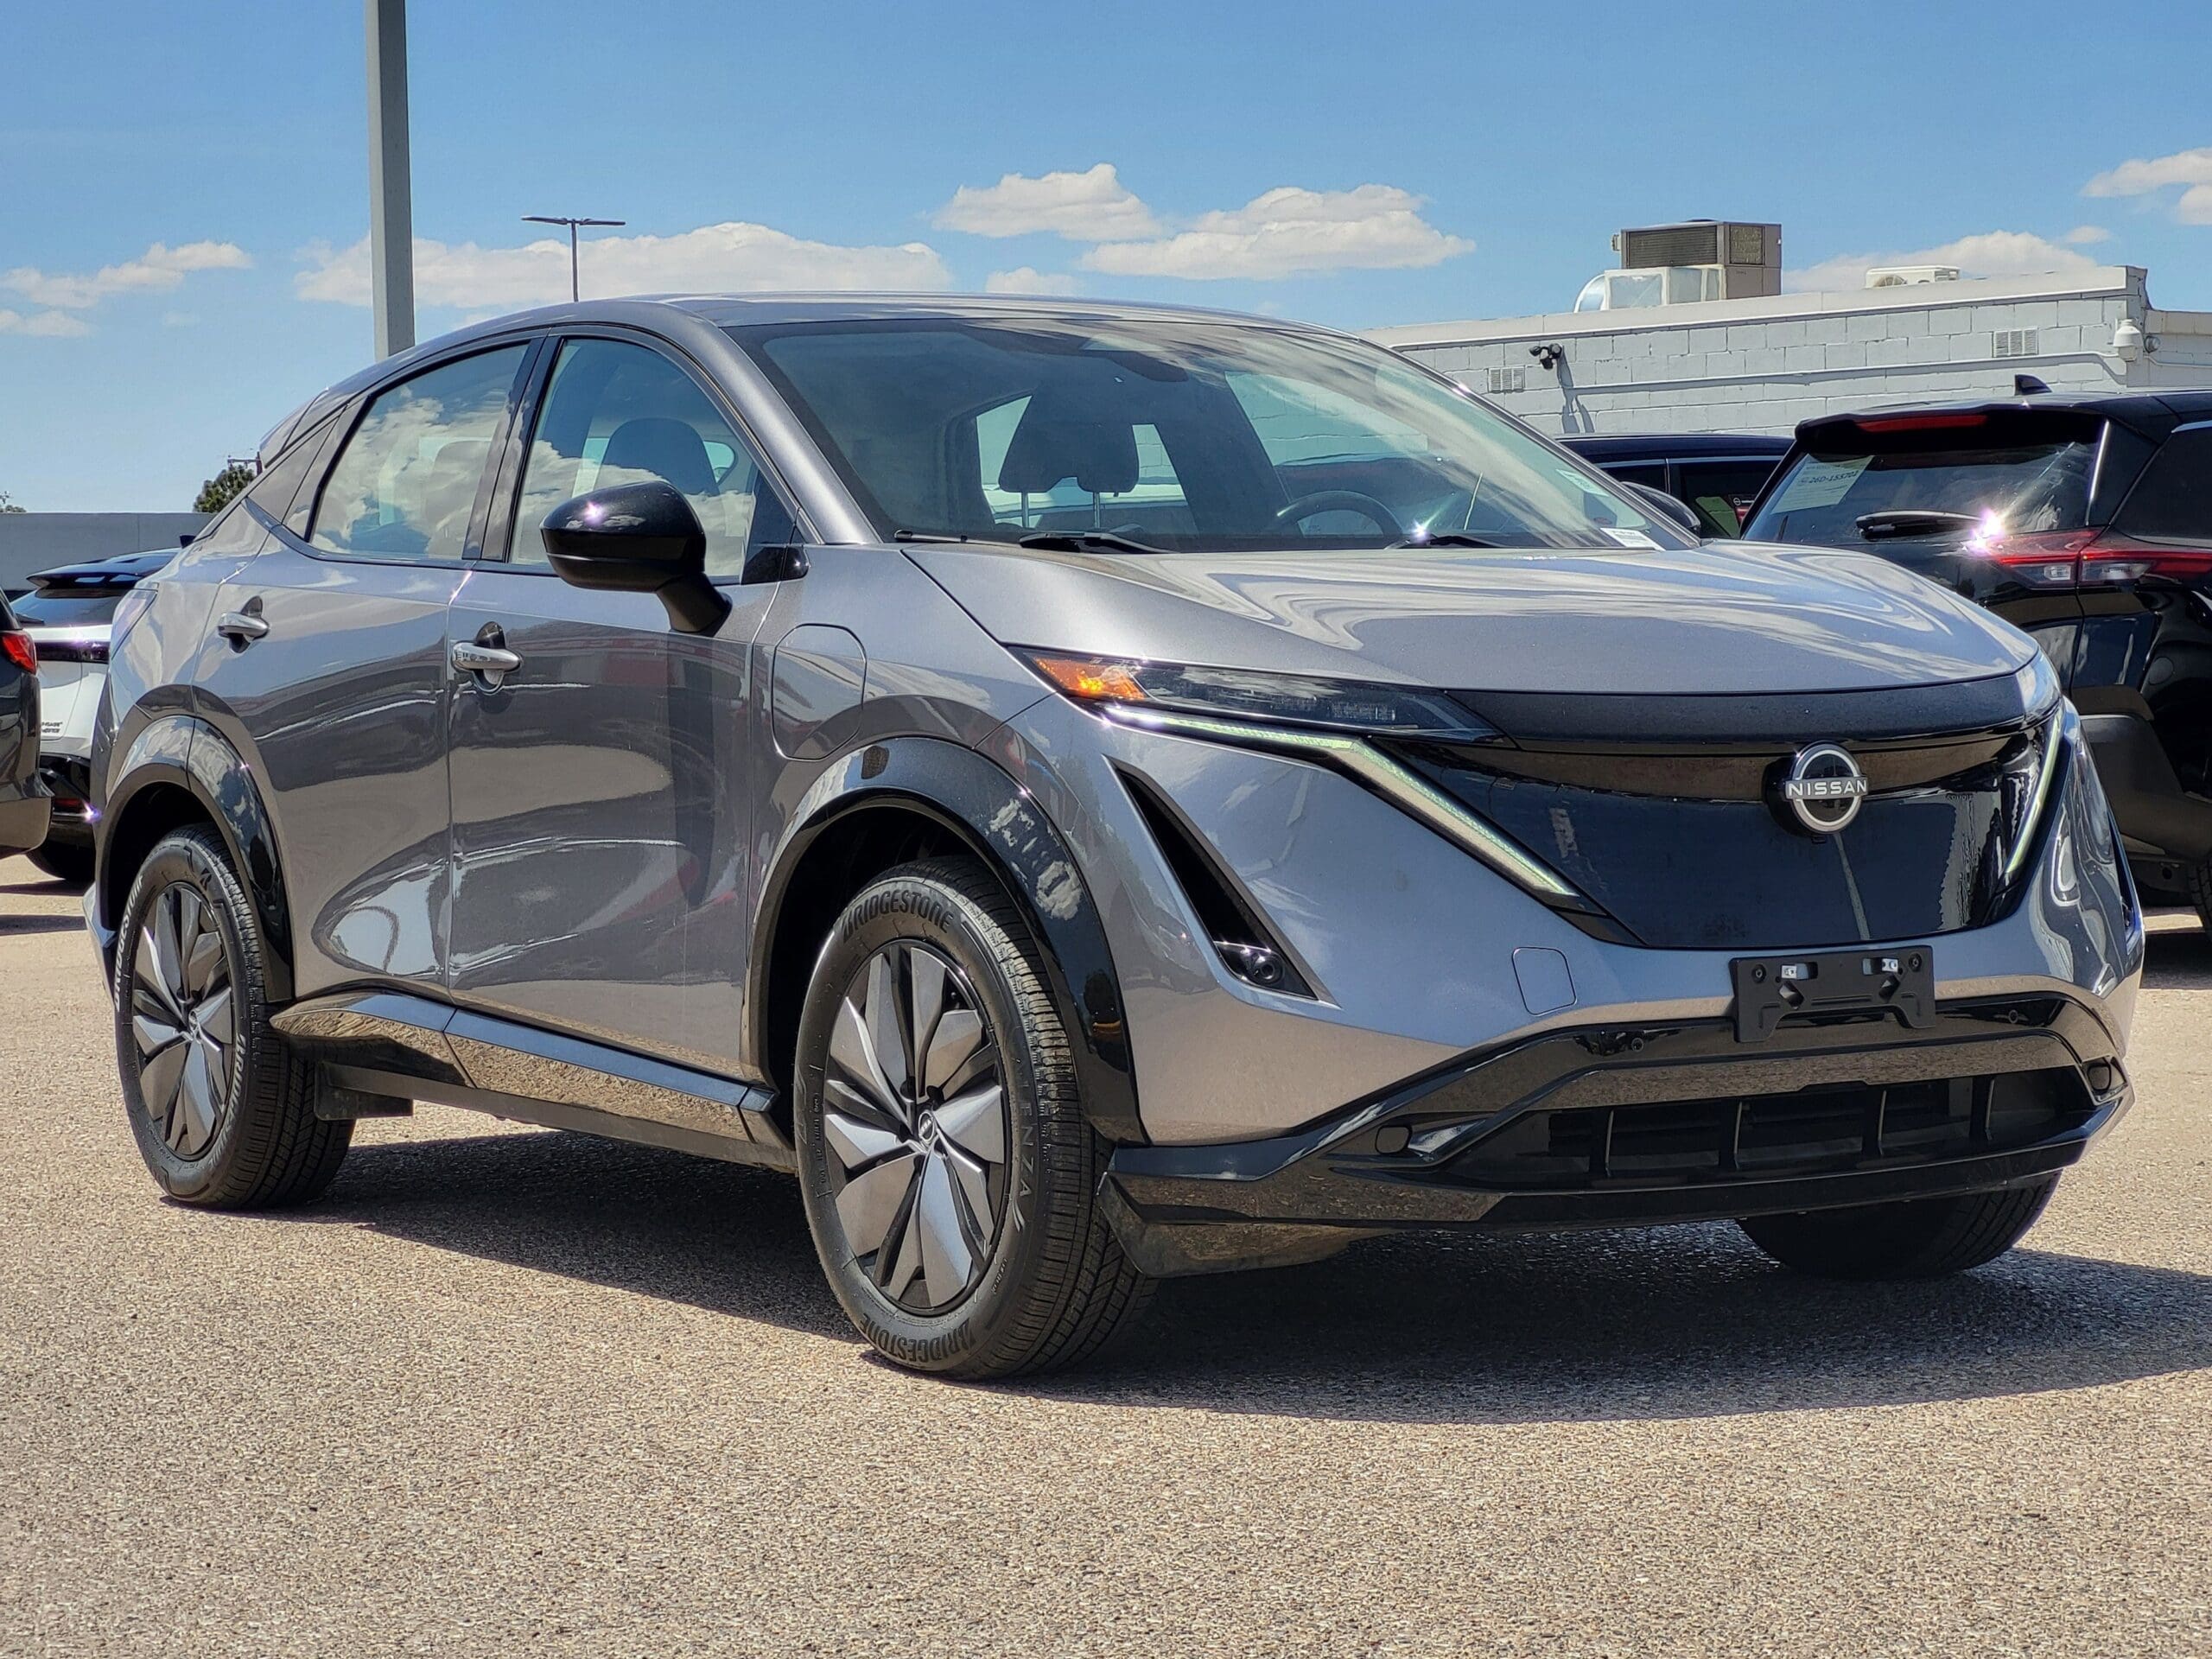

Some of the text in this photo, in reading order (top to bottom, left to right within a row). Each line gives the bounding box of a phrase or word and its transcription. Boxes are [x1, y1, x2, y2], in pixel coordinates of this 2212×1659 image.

[1788, 779, 1867, 797] NISSAN
[841, 889, 955, 943] BRIDGESTONE
[860, 1313, 976, 1363] BRIDGESTONE
